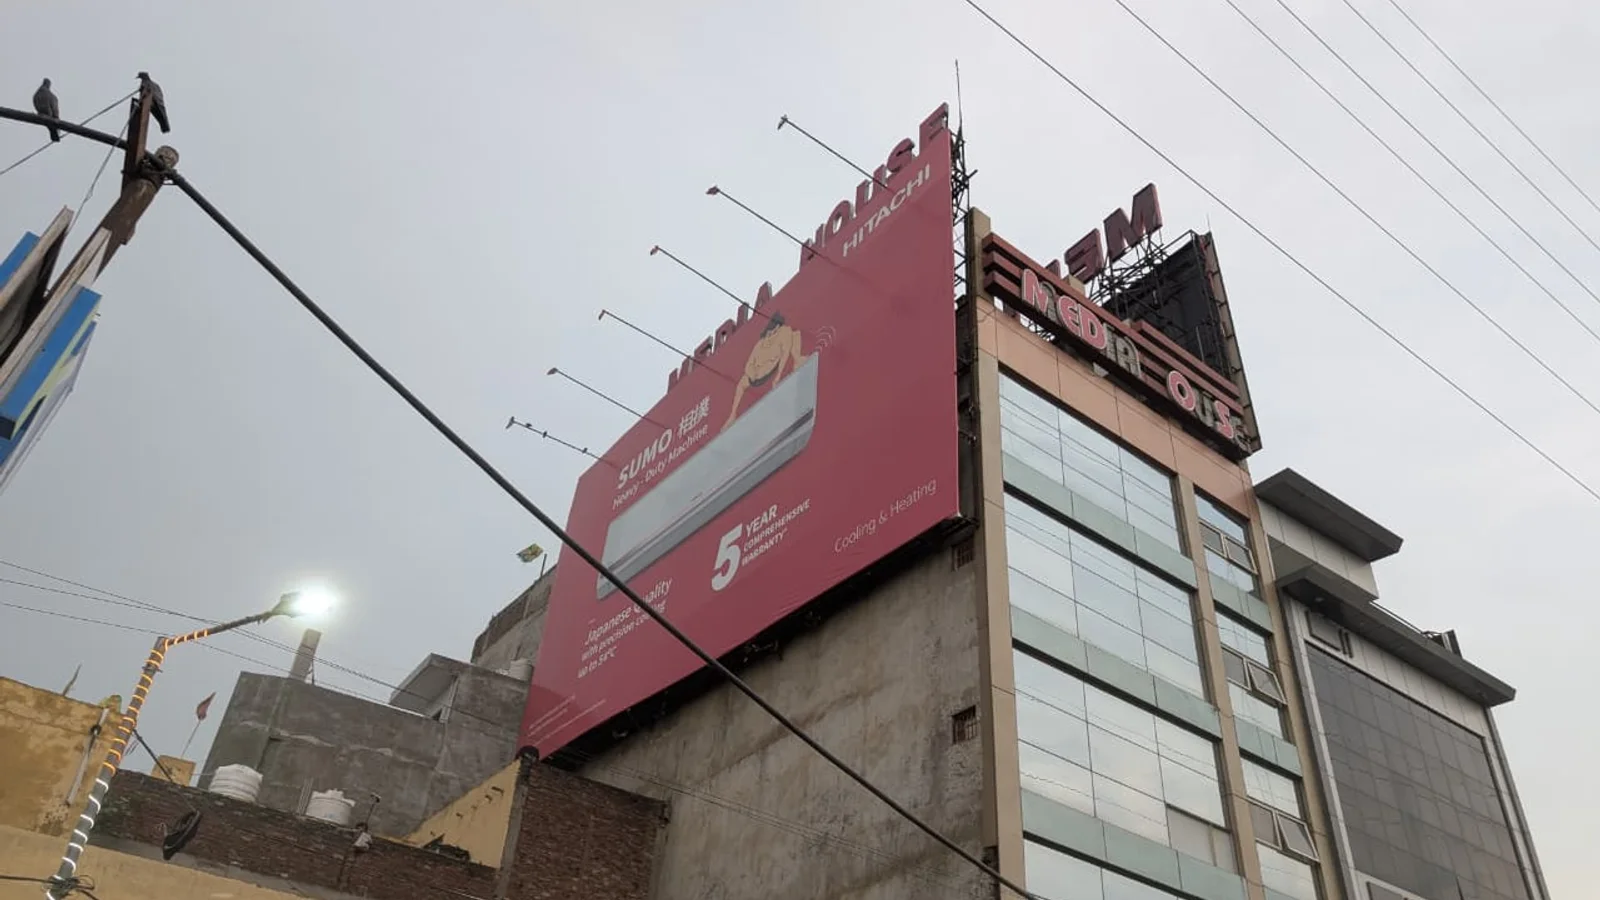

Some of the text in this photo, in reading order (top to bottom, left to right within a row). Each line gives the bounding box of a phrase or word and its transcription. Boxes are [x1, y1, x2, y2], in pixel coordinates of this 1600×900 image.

[843, 164, 930, 257] HITACHI
[1022, 269, 1141, 378] MEDIA
[612, 479, 640, 510] Heavy
[645, 459, 667, 482] Duty
[668, 424, 709, 463] Machine
[617, 428, 673, 490] SUMO
[743, 498, 811, 552] COMPREHENSIVE
[746, 504, 778, 538] YEAR
[834, 478, 937, 554] Cooling & Heating
[711, 523, 743, 592] 5
[581, 644, 599, 662] with
[598, 621, 635, 653] precision
[584, 607, 632, 646] Japanese
